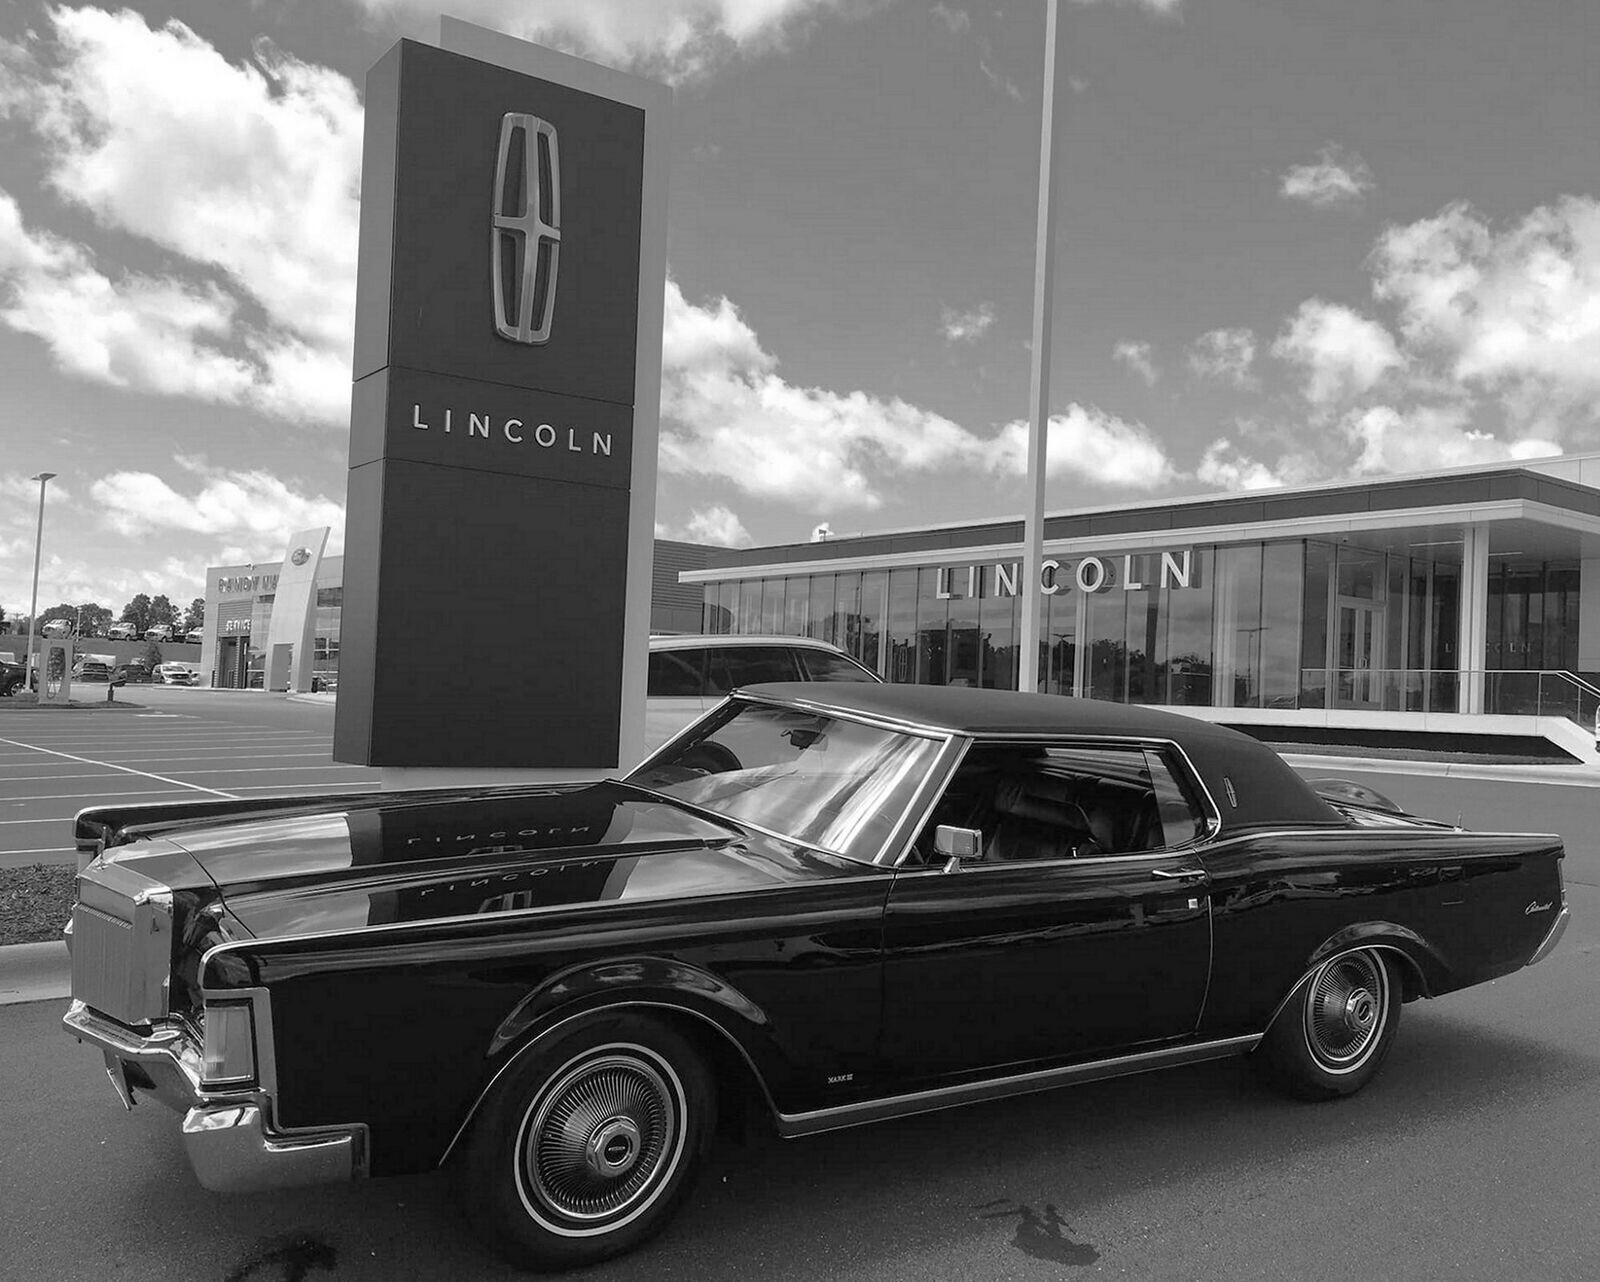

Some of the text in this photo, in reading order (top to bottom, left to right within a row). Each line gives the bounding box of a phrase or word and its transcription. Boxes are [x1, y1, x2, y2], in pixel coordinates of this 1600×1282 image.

[413, 404, 612, 456] LINCOLN
[936, 550, 1191, 599] LINCOLN
[1445, 642, 1531, 654] LOLN
